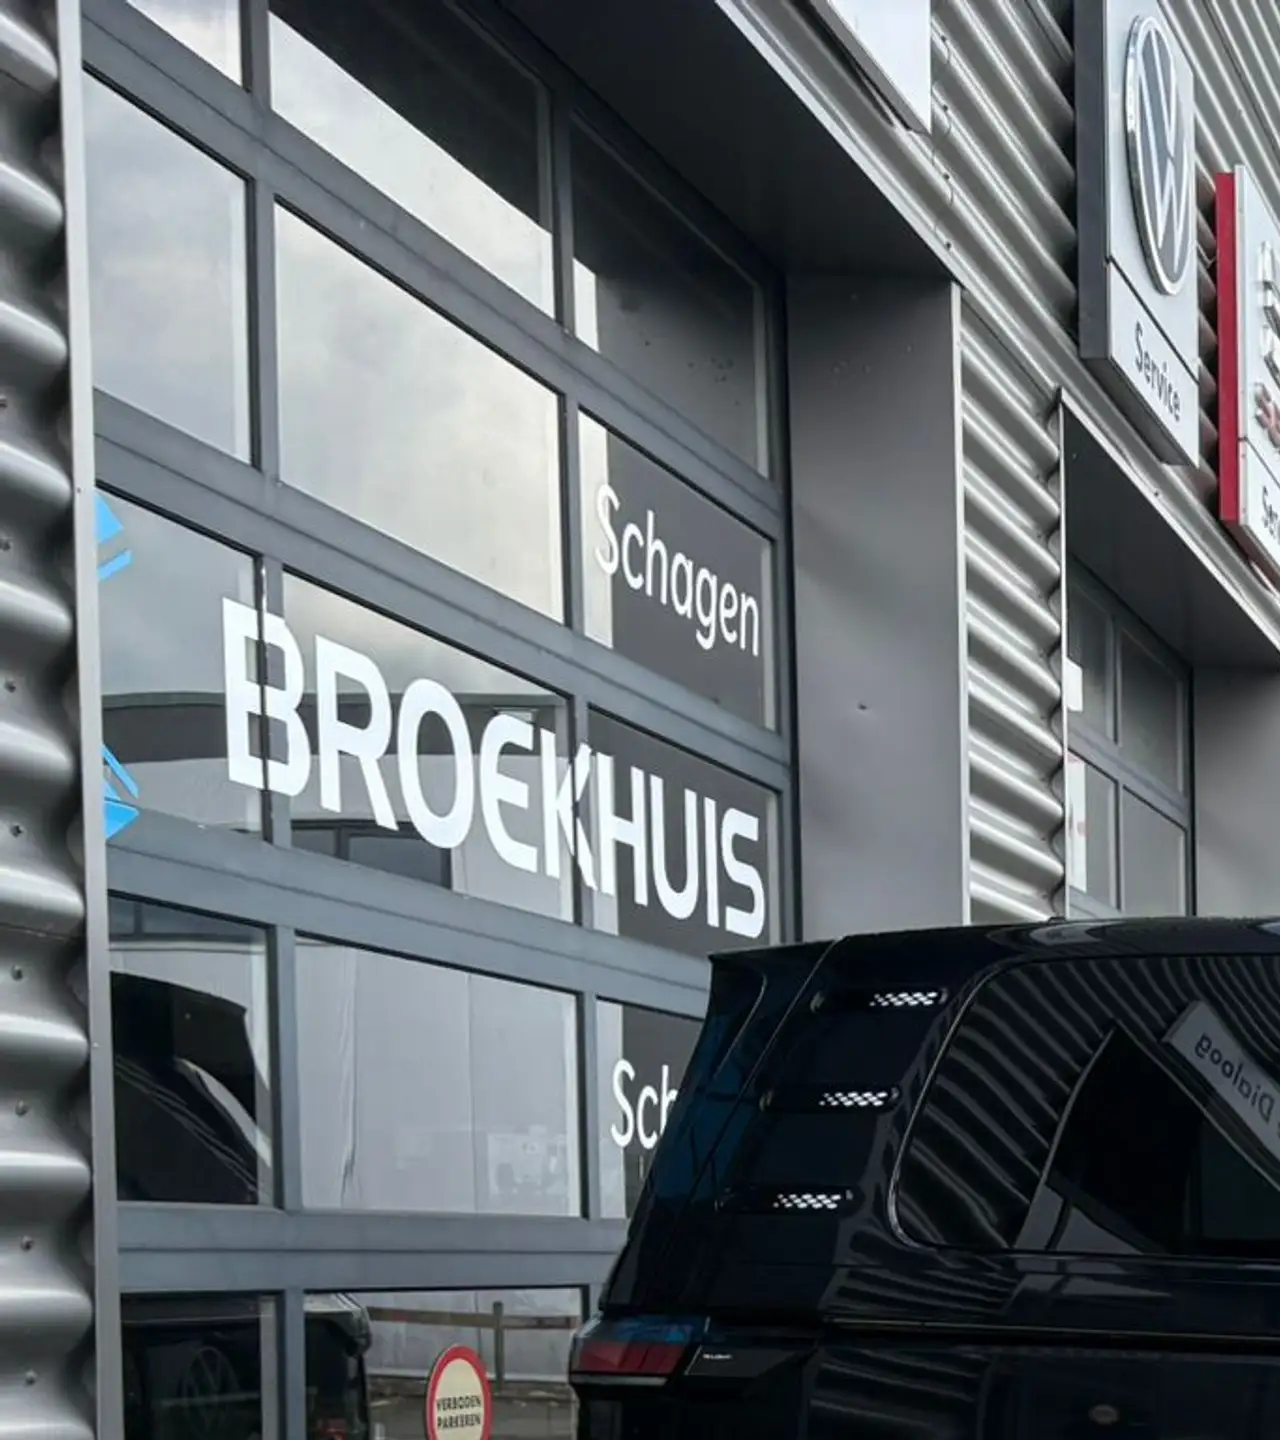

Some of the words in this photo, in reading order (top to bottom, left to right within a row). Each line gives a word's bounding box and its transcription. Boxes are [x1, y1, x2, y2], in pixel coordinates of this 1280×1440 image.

[1135, 320, 1180, 422] Service
[595, 486, 761, 657] Schagen
[222, 598, 765, 939] BROEKHUIS
[436, 1395, 482, 1411] VERBODEN
[436, 1412, 482, 1430] PARKEREN
